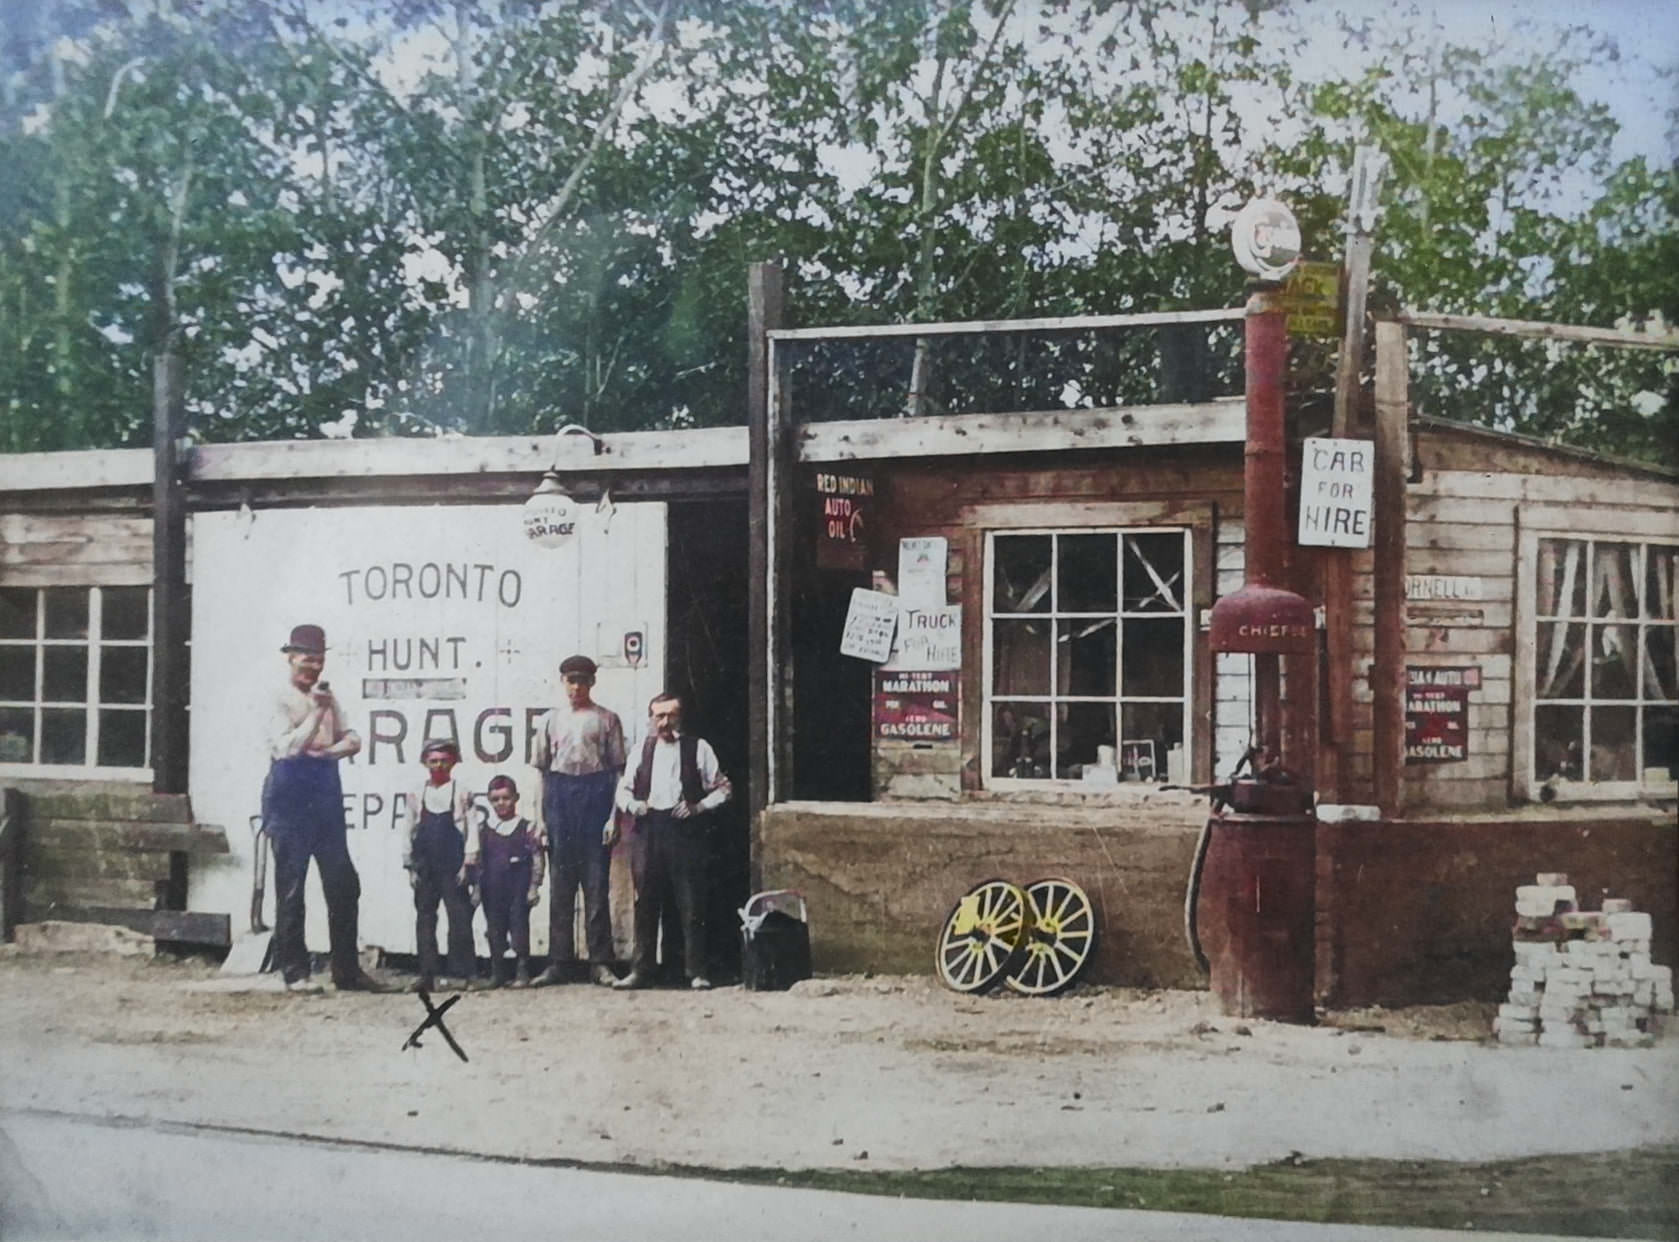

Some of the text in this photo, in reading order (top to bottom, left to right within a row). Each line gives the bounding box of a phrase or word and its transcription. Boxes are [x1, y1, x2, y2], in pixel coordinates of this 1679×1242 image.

[1313, 448, 1365, 473] CAR
[816, 472, 838, 494] RED
[1318, 481, 1354, 500] FOR
[824, 497, 852, 517] AUTO
[828, 520, 847, 539] OIL
[1306, 504, 1368, 536] HIRE
[338, 562, 522, 608] TORONTO
[905, 608, 956, 630] TRUCK
[367, 636, 483, 672] HUNT.
[882, 679, 950, 694] MARATHON
[1407, 700, 1461, 713] ARATHON
[880, 722, 952, 736] GASOLENE
[1406, 744, 1464, 759] ASOLENE
